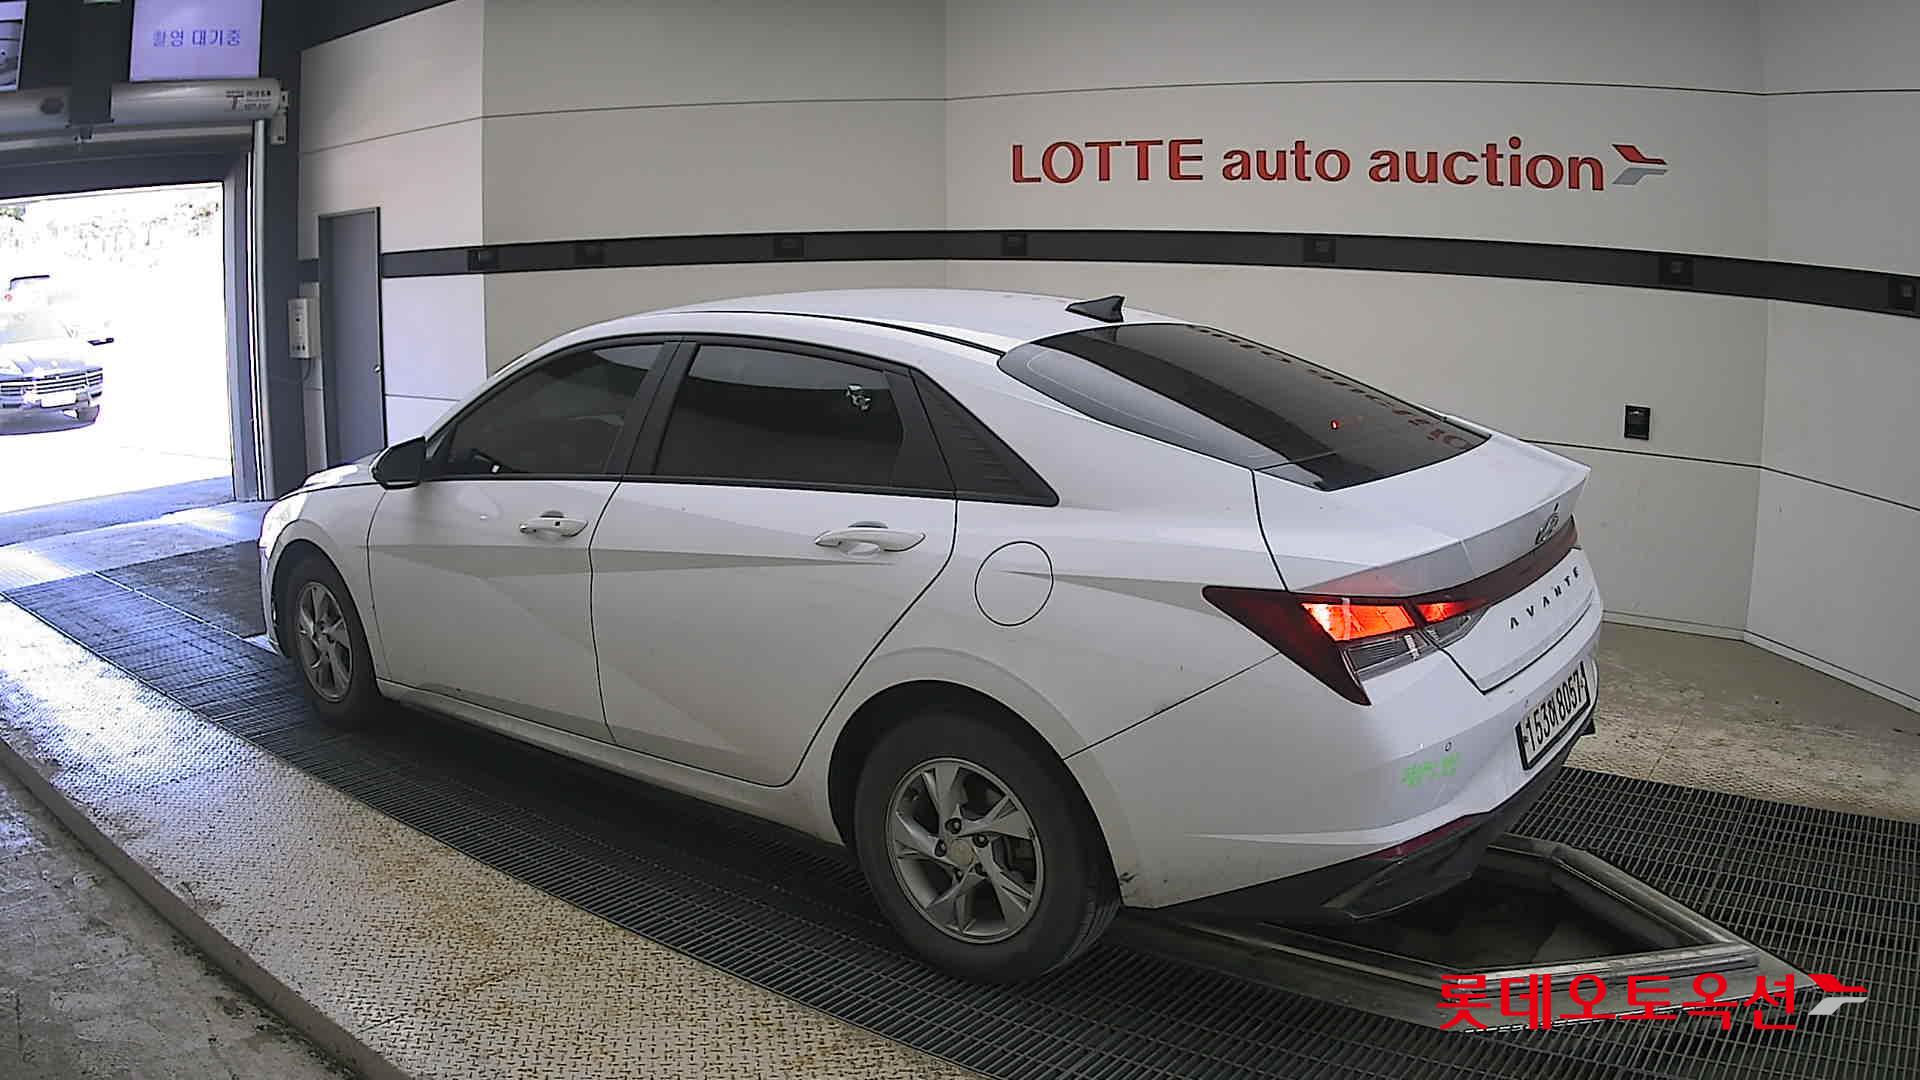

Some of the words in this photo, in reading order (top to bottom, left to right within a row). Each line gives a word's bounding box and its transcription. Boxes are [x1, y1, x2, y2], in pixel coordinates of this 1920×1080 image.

[192, 28, 241, 47] 대기중
[1011, 138, 1204, 184] LOTTE
[1221, 139, 1351, 183] auto
[1368, 136, 1605, 191] auction
[1509, 566, 1580, 630] AVANTE
